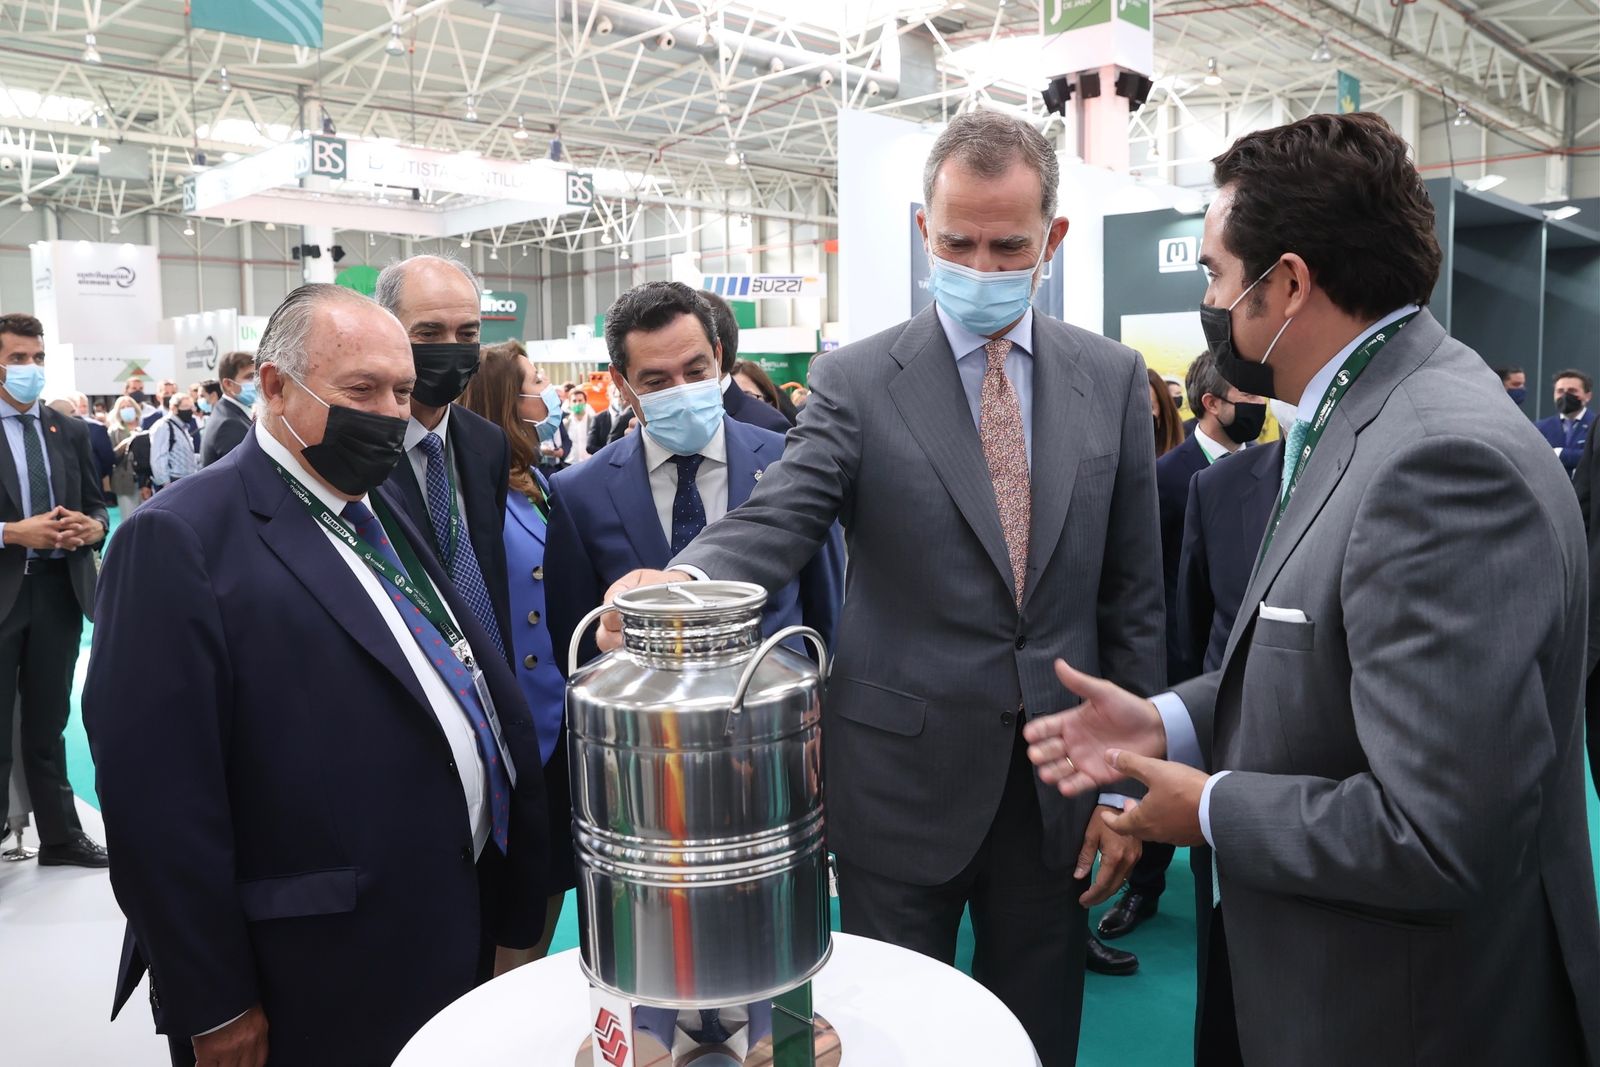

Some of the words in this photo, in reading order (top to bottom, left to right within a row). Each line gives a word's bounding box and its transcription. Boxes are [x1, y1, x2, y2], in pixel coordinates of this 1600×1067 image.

[313, 139, 345, 174] BS
[567, 174, 592, 204] BS
[752, 278, 803, 292] BUZZI
